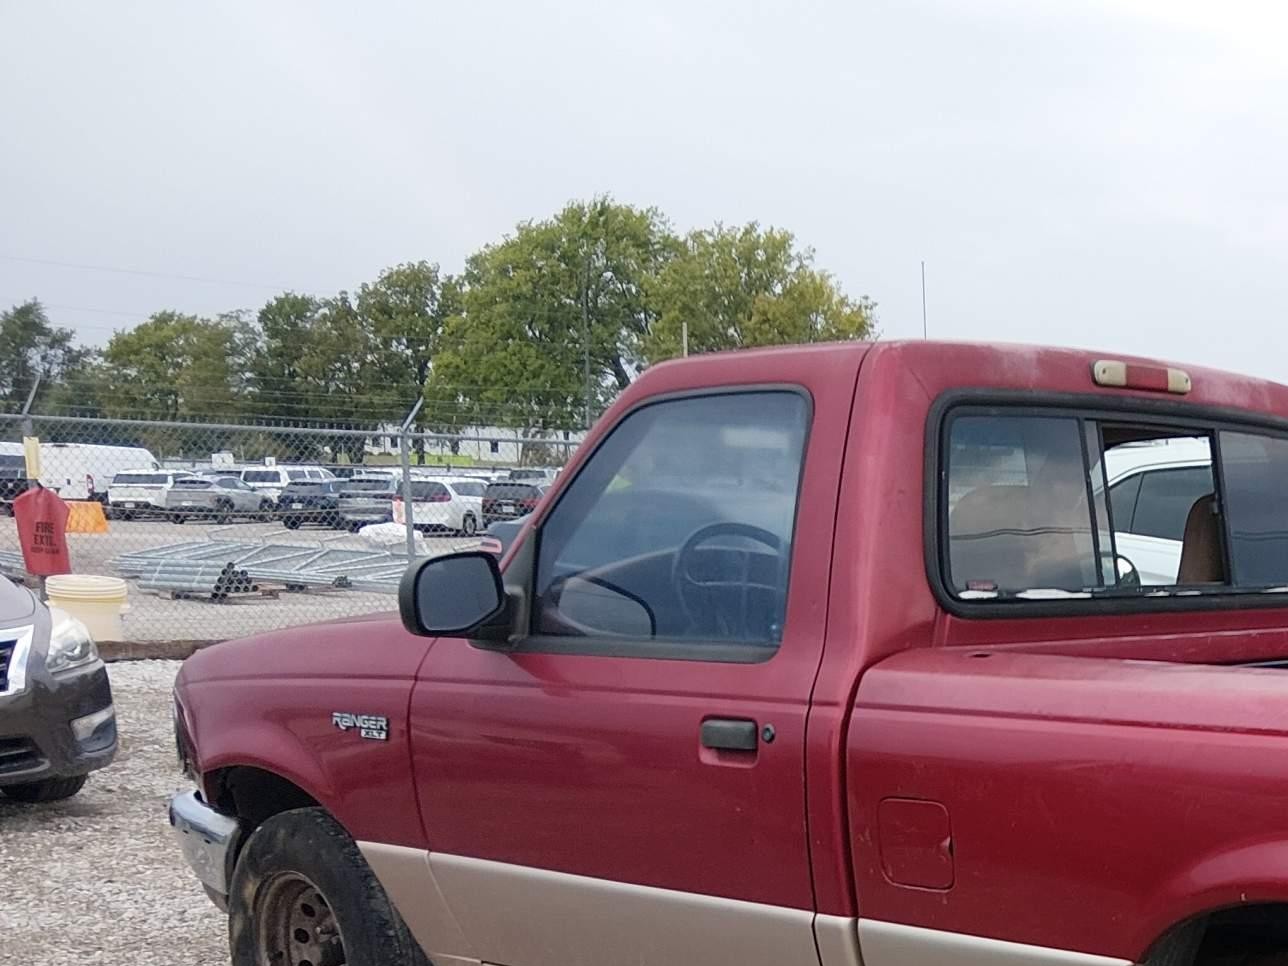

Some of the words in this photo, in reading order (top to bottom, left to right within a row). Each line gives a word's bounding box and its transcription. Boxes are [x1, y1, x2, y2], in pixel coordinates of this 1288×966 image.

[35, 521, 55, 534] FIRE
[332, 711, 389, 731] RANGER
[362, 729, 386, 739] XLT
